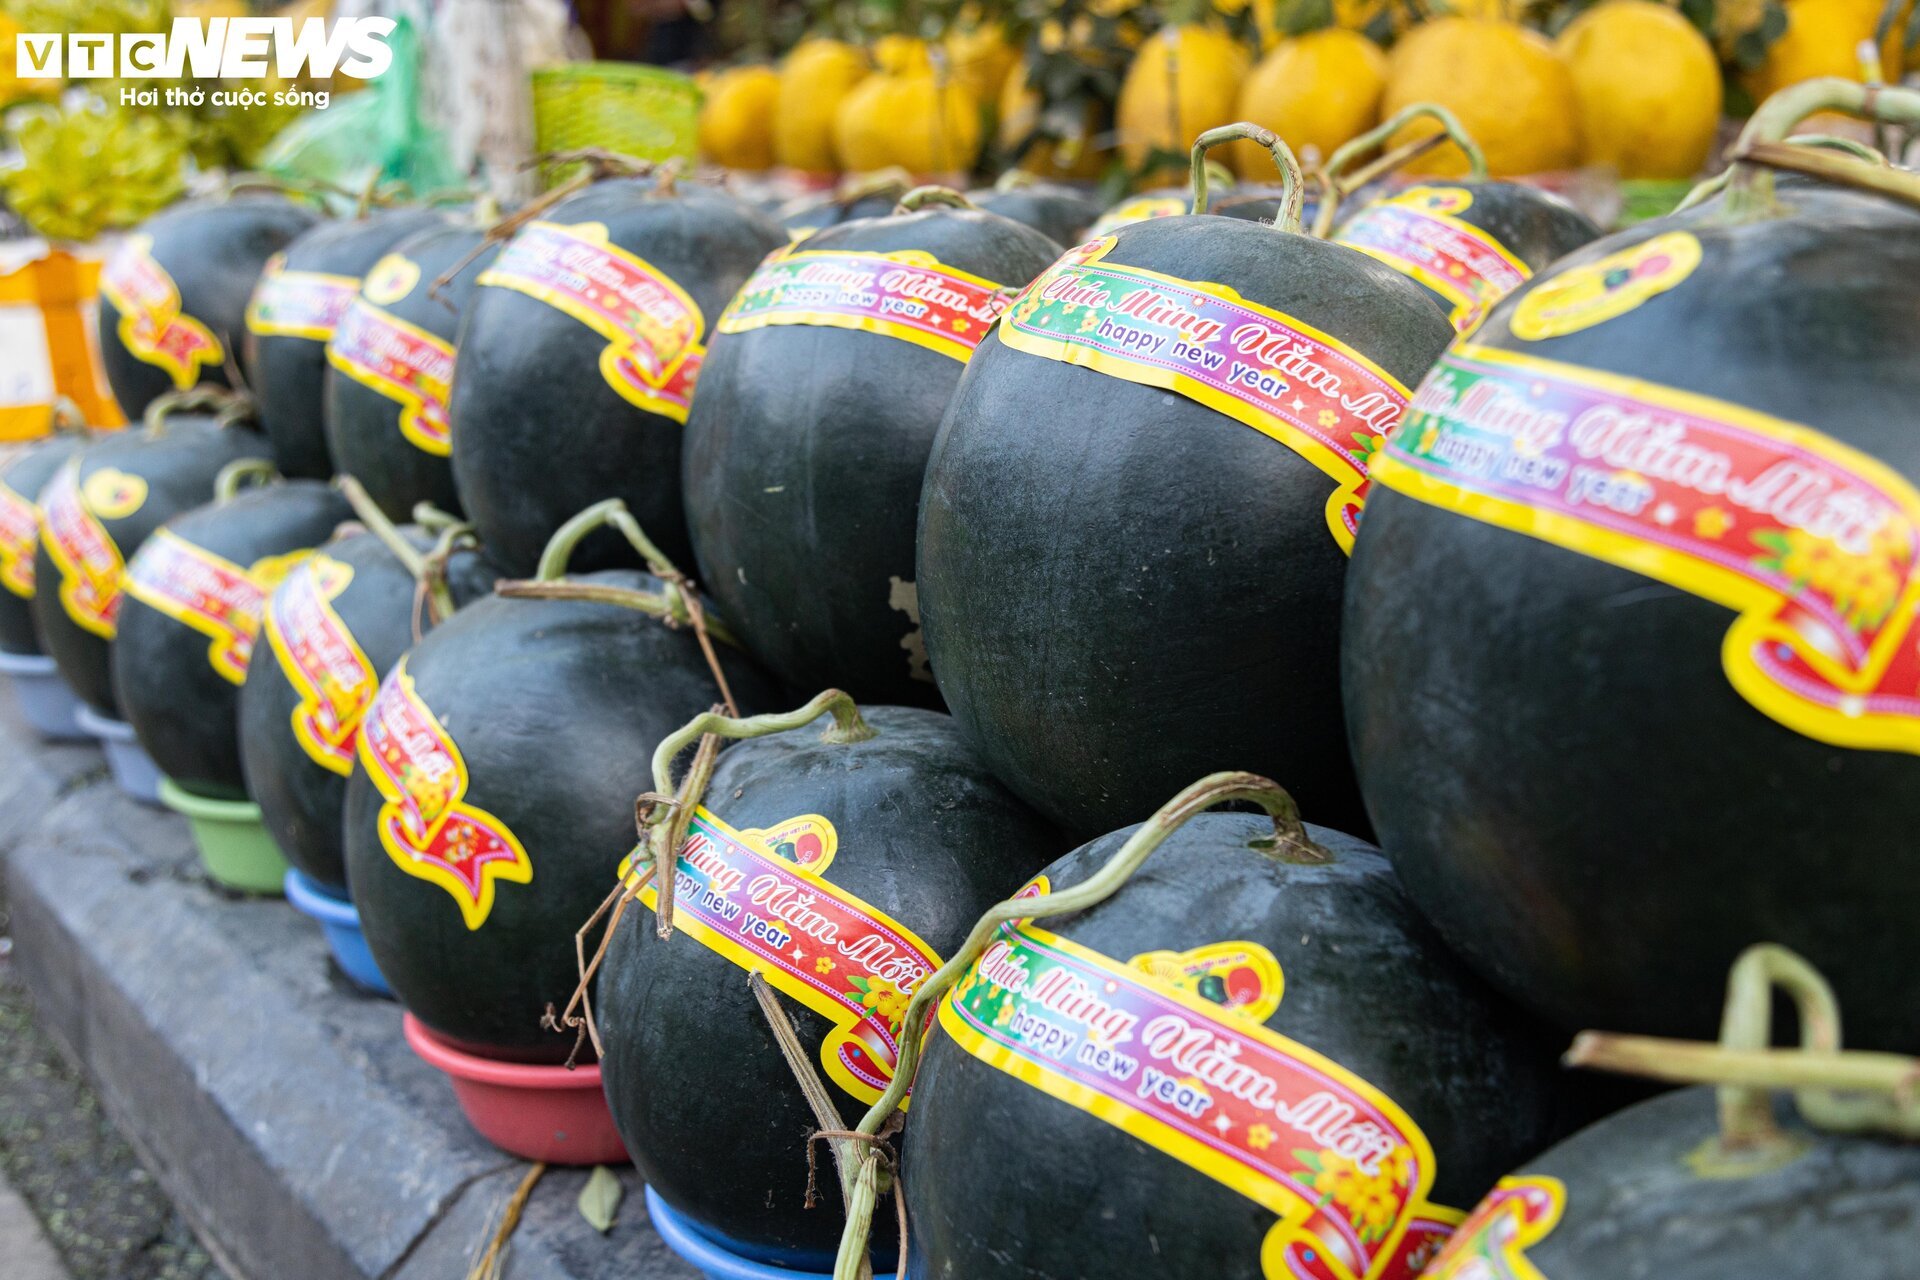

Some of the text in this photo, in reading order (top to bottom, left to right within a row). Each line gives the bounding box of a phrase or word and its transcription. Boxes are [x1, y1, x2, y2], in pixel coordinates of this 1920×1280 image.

[836, 289, 879, 308] new
[881, 295, 929, 320] year
[879, 269, 967, 312] Năm
[1042, 272, 1348, 399] Chúc Mừng Năm
[1096, 316, 1291, 402] happy new year
[702, 889, 742, 922] new
[740, 912, 792, 950] year
[746, 873, 840, 945] Năm
[837, 933, 926, 995] Mới
[978, 939, 1396, 1177] Chúc Mừng Năm Mới
[1010, 1003, 1214, 1119] happy new year
